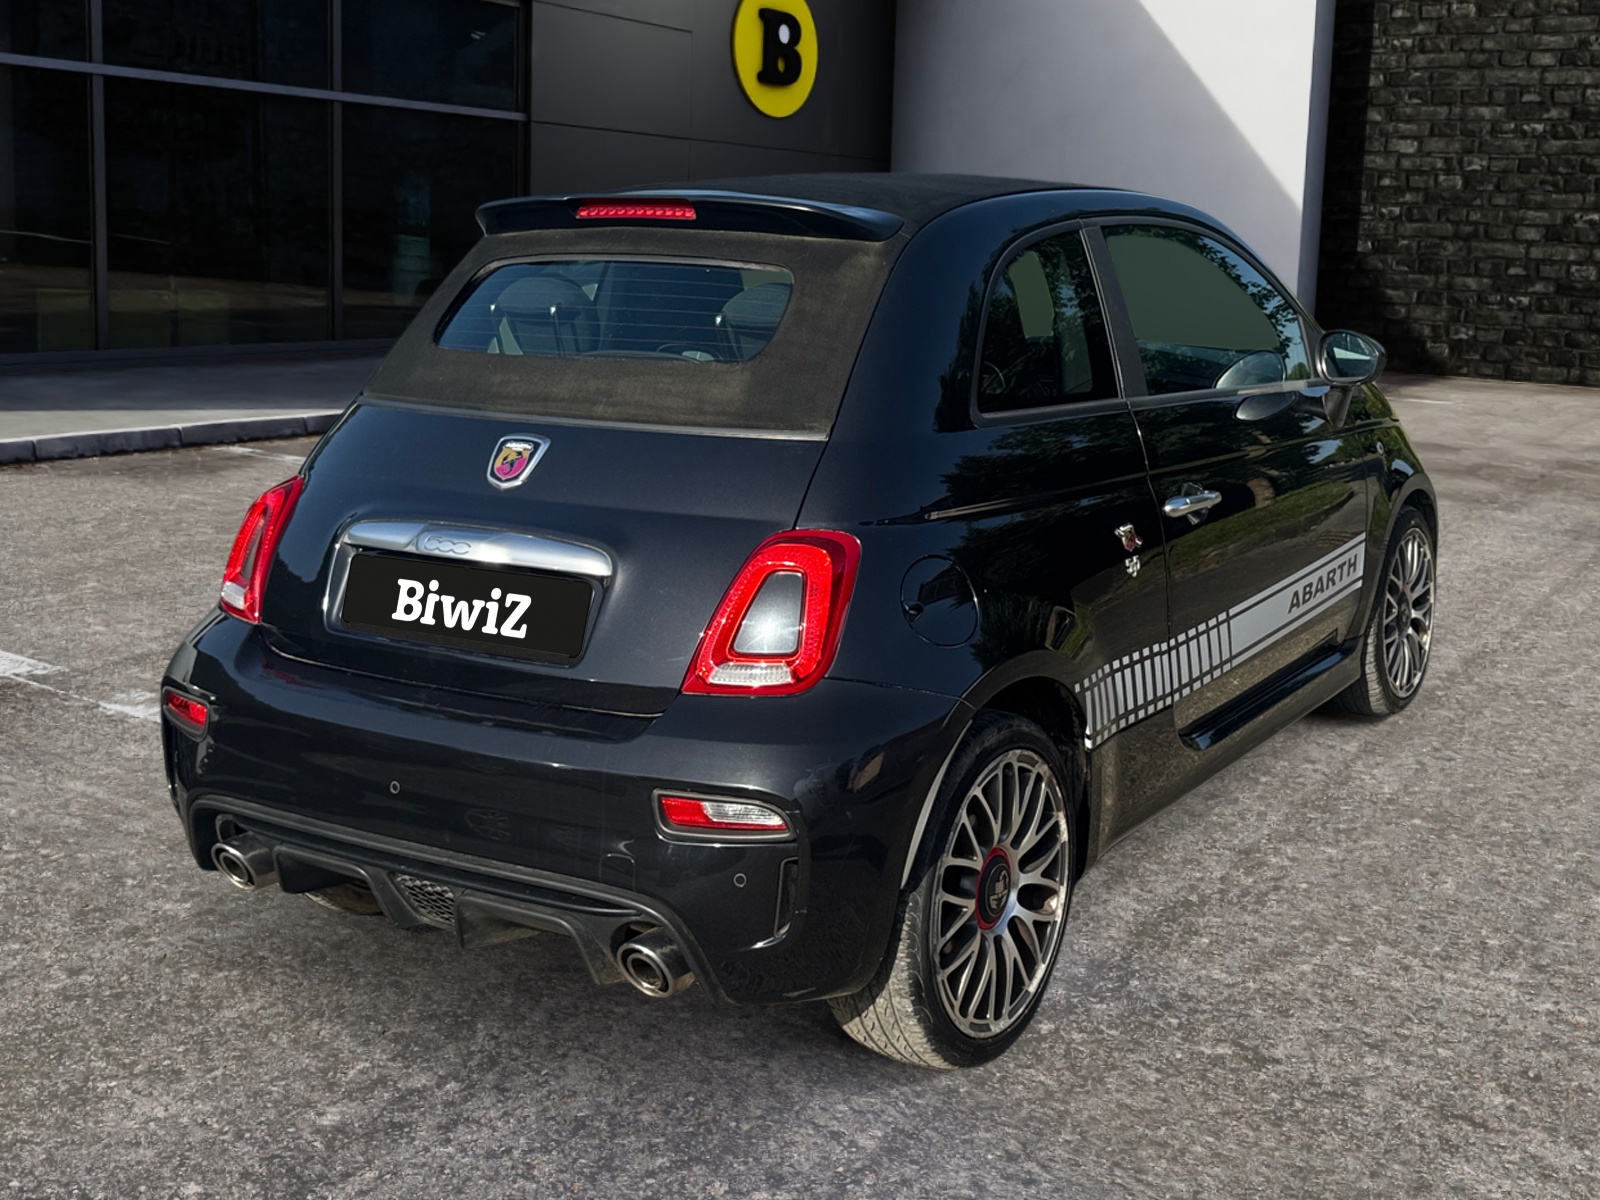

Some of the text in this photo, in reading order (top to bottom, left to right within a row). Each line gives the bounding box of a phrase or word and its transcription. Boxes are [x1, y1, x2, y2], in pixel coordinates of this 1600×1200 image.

[757, 7, 803, 87] B
[391, 578, 532, 639] BiwiZ
[1287, 553, 1358, 614] ABARTH
